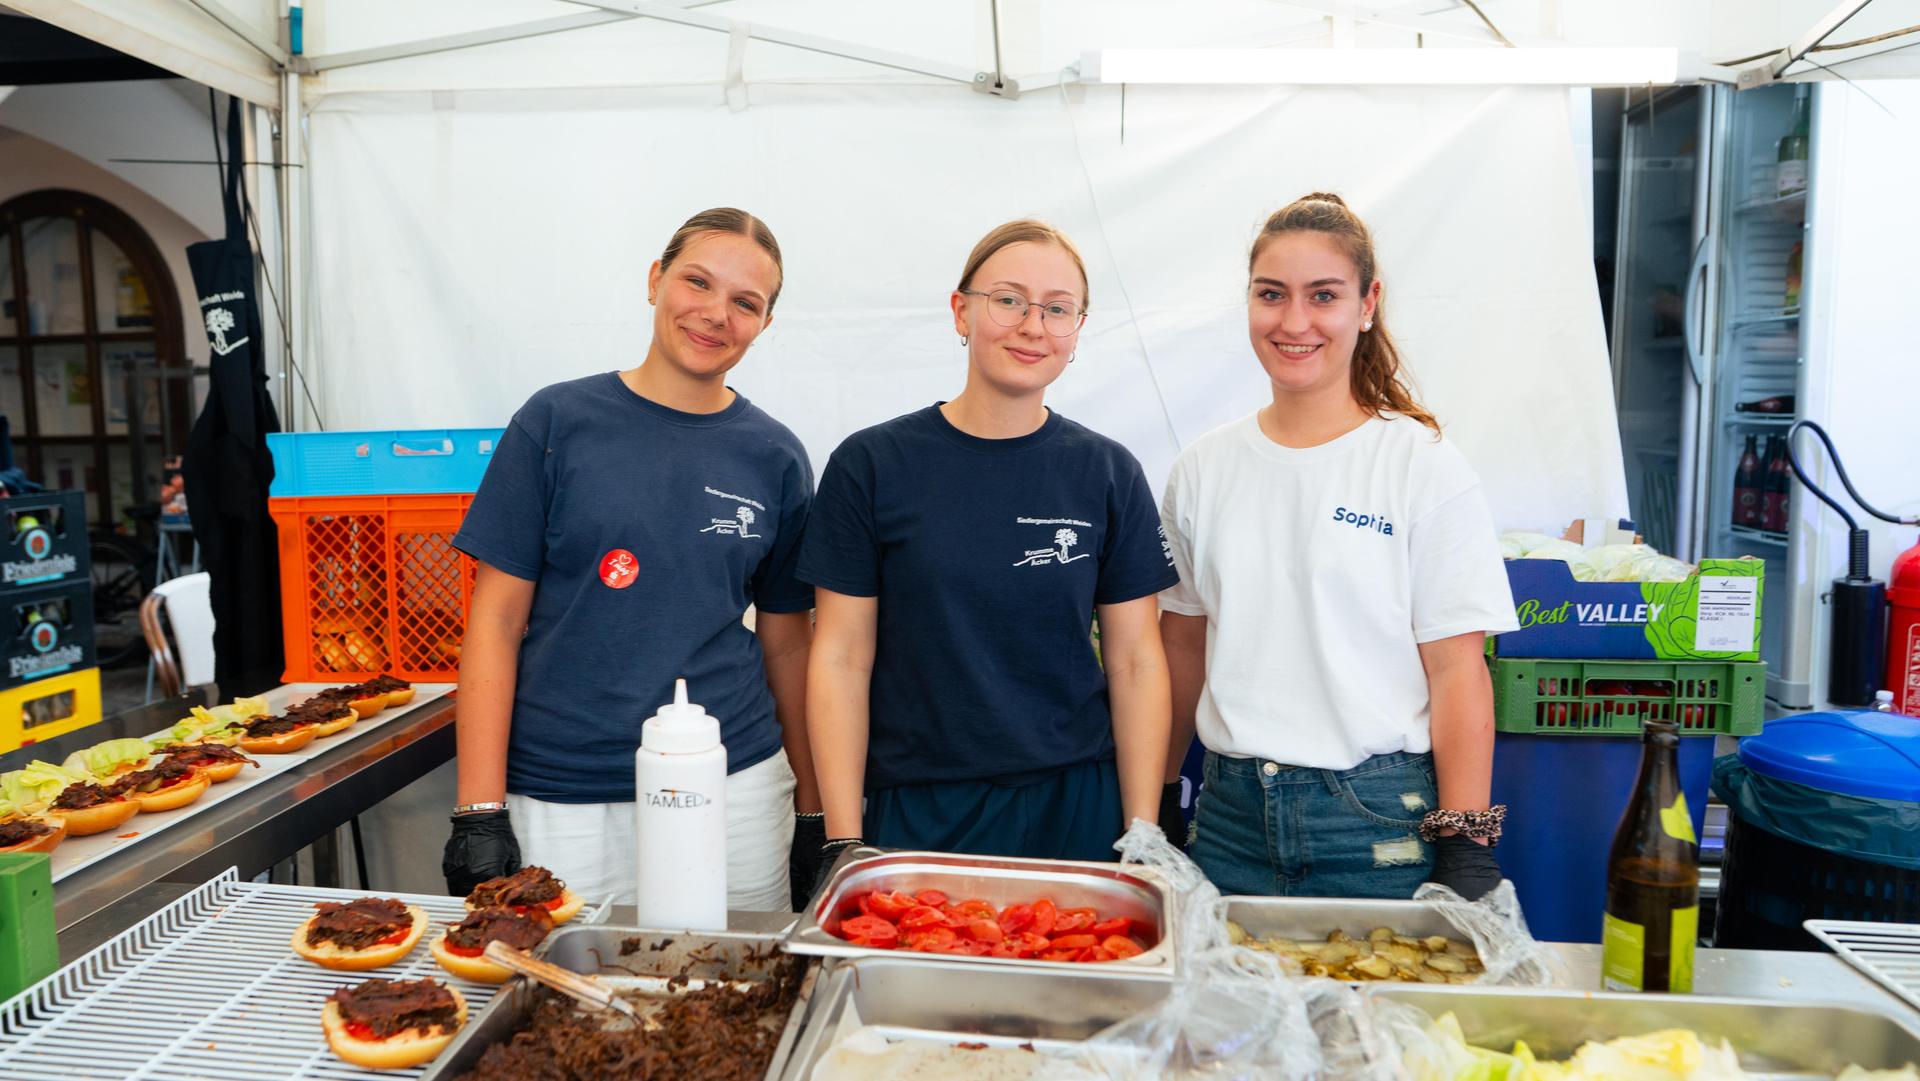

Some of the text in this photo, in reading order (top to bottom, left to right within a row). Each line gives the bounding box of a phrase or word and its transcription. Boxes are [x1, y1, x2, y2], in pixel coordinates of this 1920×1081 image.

[1332, 506, 1394, 536] Sophia
[1517, 599, 1665, 629] Best VALLEY
